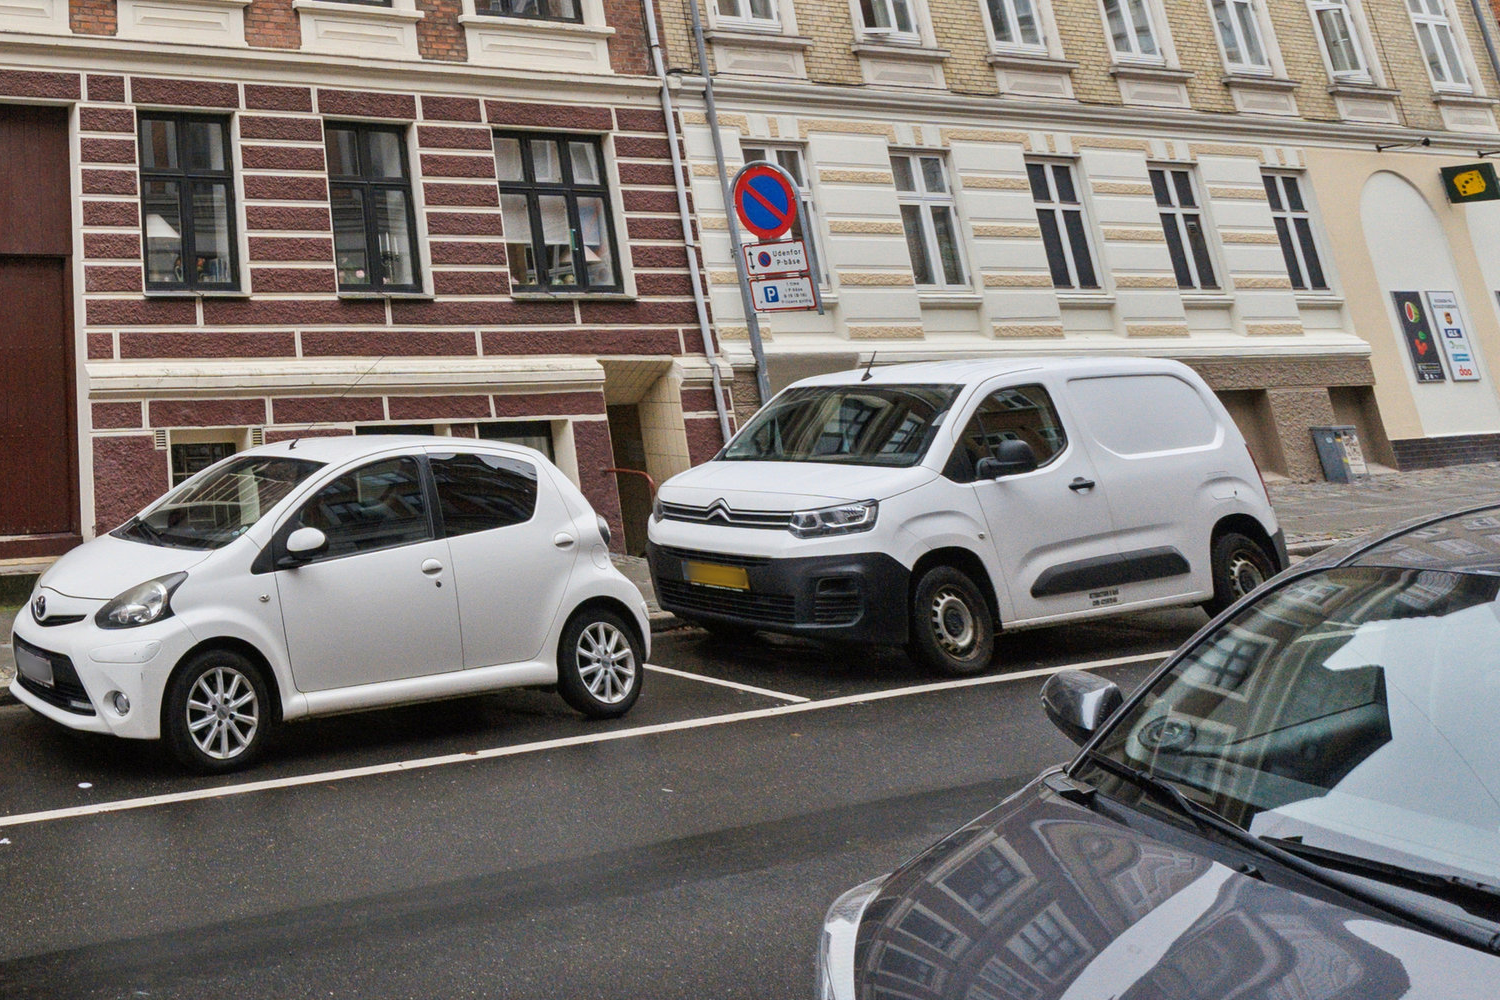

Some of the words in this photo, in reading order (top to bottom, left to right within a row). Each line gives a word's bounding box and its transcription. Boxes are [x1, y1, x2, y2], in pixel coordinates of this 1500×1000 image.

[772, 249, 801, 257] Udenfor
[776, 258, 801, 266] P-båse
[766, 287, 777, 302] P
